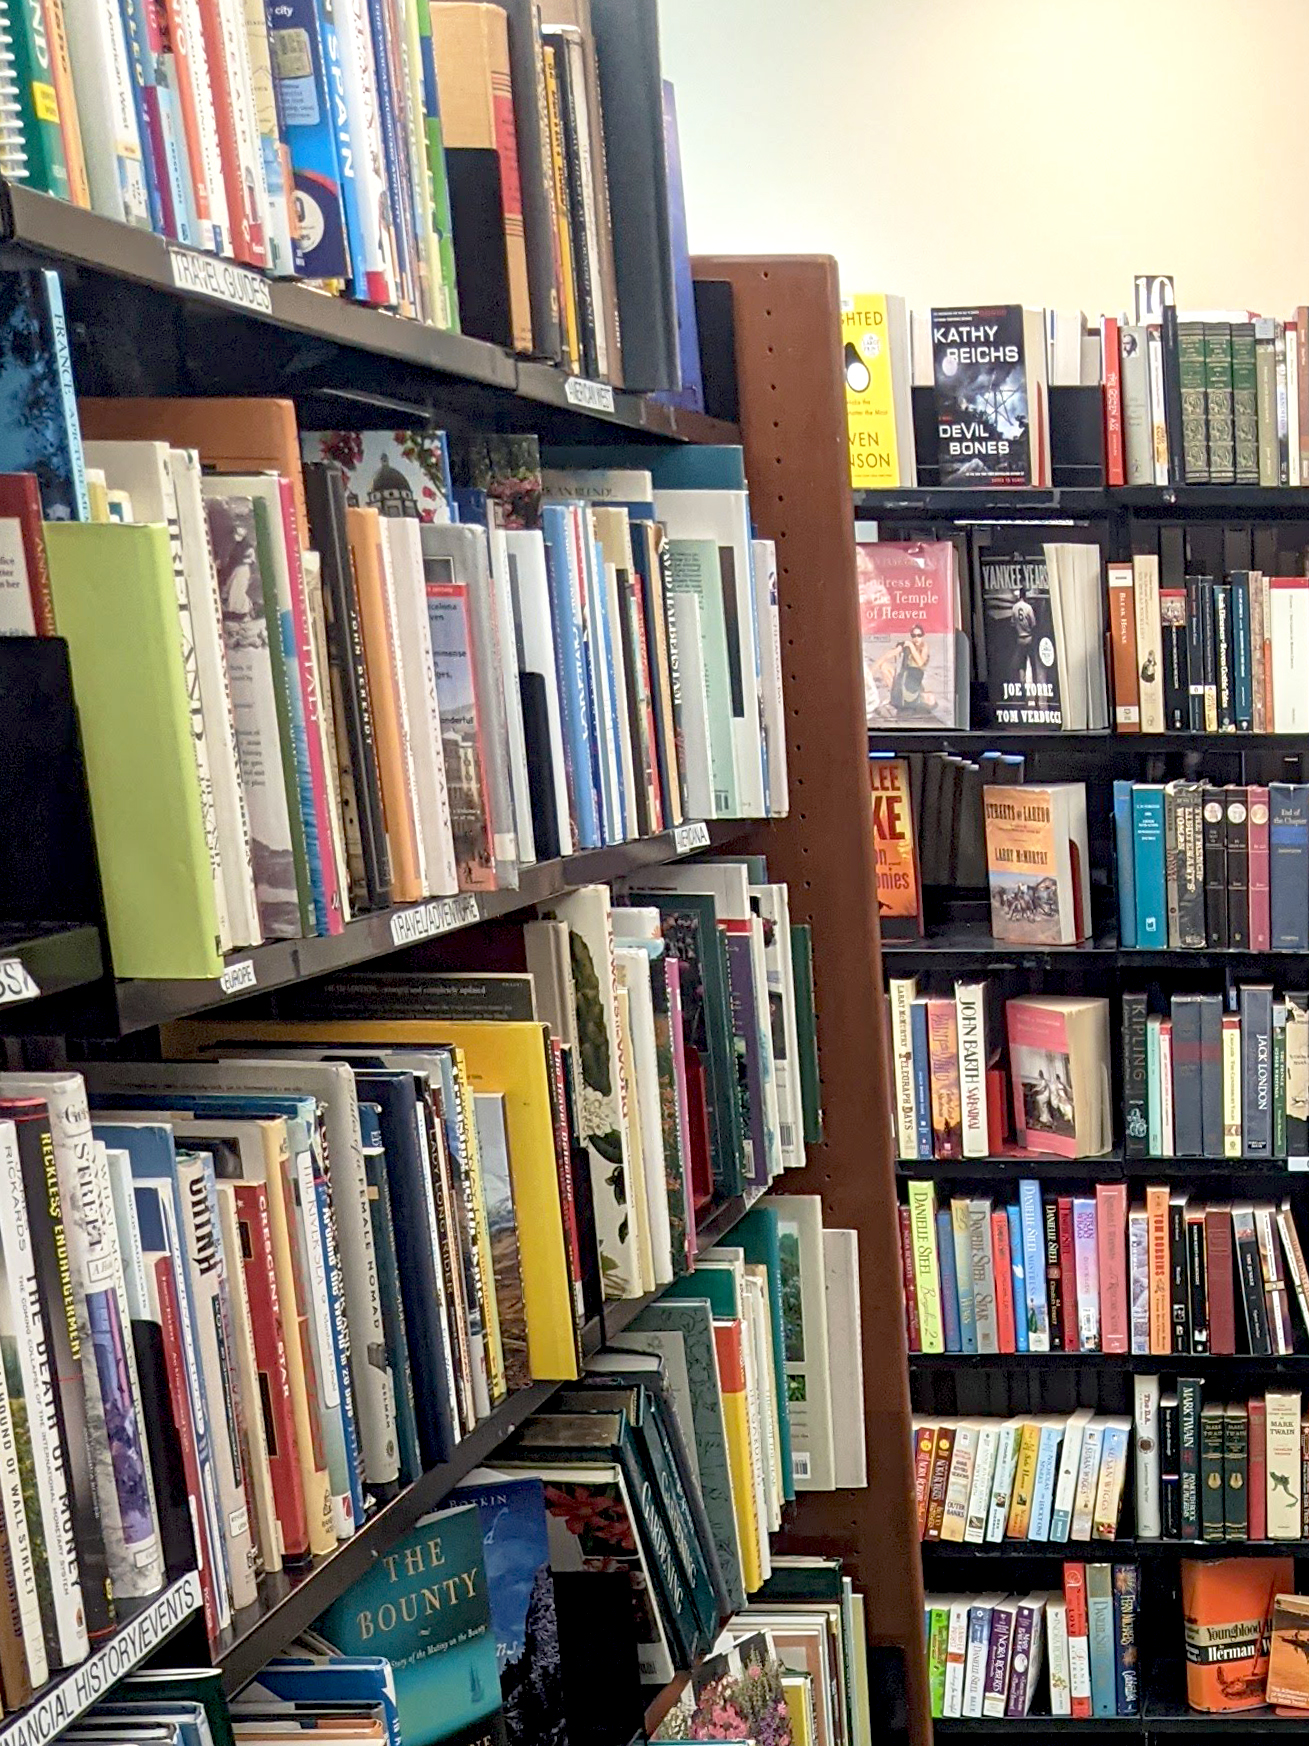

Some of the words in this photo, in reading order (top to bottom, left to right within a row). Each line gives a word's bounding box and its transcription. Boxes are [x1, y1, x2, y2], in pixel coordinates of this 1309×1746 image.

[329, 33, 355, 179] SPAIN
[174, 251, 216, 294] TRAVEL
[223, 269, 271, 310] GUIDES
[934, 326, 998, 344] KATHY
[948, 347, 1019, 363] REICHS
[939, 422, 989, 440] DEVIL
[950, 441, 1009, 456] BONES
[915, 577, 932, 588] Me
[982, 564, 1021, 589] YANKEE
[881, 607, 927, 619] Heaven
[895, 592, 938, 605] Temple
[351, 610, 362, 655] JOHN
[1003, 684, 1021, 698] JOE
[1025, 683, 1053, 697] TORRE
[997, 710, 1018, 723] TOM
[1021, 710, 1061, 724] VERDUCCI
[996, 851, 1014, 863] LARRY
[395, 899, 478, 944] TRAVEL/ADVENTURE
[223, 964, 254, 991] EUROPE
[959, 997, 978, 1036] JOHN
[1130, 1004, 1146, 1081] KIPLING
[1256, 1035, 1268, 1064] JACK
[964, 1040, 980, 1084] BARTH
[900, 1052, 911, 1103] TELEGRAPH
[1257, 1066, 1268, 1110] LONDON
[902, 1106, 913, 1130] DAYS
[428, 1128, 441, 1177] LADY
[914, 1193, 931, 1242] DANIELLE
[1155, 1214, 1164, 1233] TOM
[39, 1134, 60, 1218] RECKLESS
[54, 1226, 82, 1359] ENDANGERMENT
[257, 1194, 280, 1313] CRESCENT
[918, 1246, 933, 1276] STEEL
[1155, 1236, 1165, 1276] ROBBINS
[1183, 1388, 1194, 1413] MARK
[1184, 1414, 1194, 1447] TWAIN
[1270, 1428, 1295, 1436] TWAIN
[381, 1536, 446, 1584] THE
[355, 1566, 479, 1642] BOUNTY
[77, 1579, 196, 1705] HISTORY/EVENTS
[996, 1634, 1008, 1658] NORA
[1207, 1626, 1260, 1642] Youngblood
[1208, 1646, 1255, 1662] Herman
[992, 1660, 1005, 1692] ROBERTS
